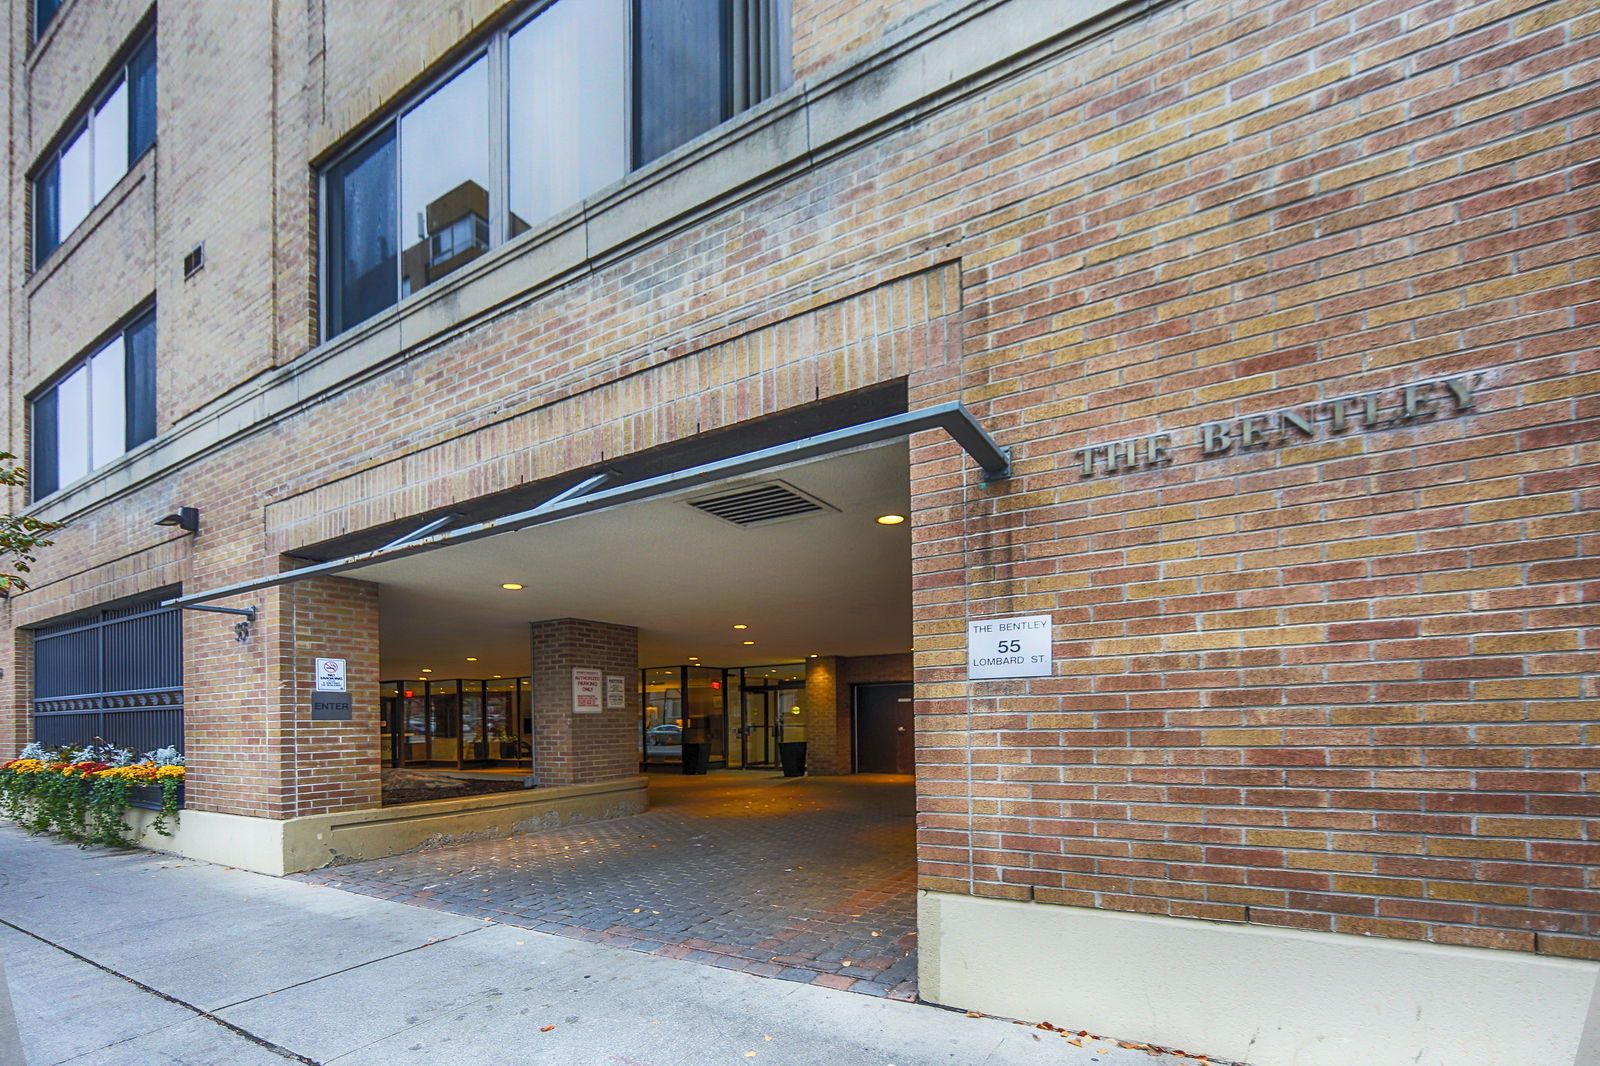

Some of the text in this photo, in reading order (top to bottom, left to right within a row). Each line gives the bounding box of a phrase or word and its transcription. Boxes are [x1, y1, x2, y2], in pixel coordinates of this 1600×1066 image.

[1074, 371, 1490, 478] THE BENTLEY
[973, 621, 1047, 633] THE BENTLEY
[997, 639, 1021, 654] 55
[973, 656, 1025, 667] LOMBARD
[314, 702, 349, 711] ENTER
